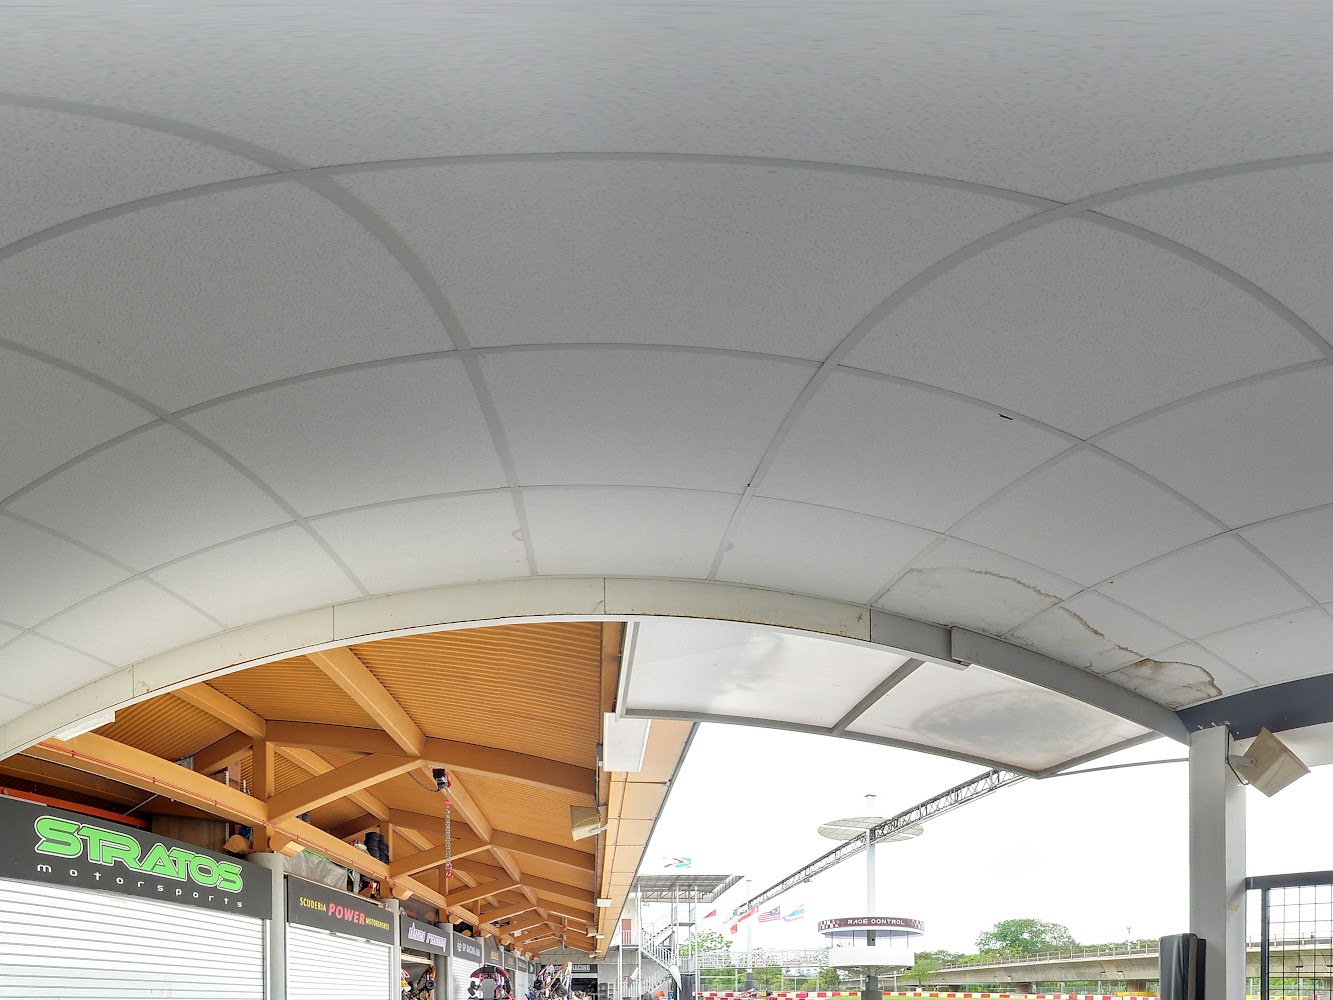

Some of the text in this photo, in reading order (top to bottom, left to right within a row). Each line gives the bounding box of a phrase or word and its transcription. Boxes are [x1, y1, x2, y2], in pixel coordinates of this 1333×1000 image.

[34, 816, 243, 893] STRATOS
[37, 864, 243, 908] motorsports
[300, 896, 327, 912] SCUDERIA
[328, 902, 366, 925] POWER
